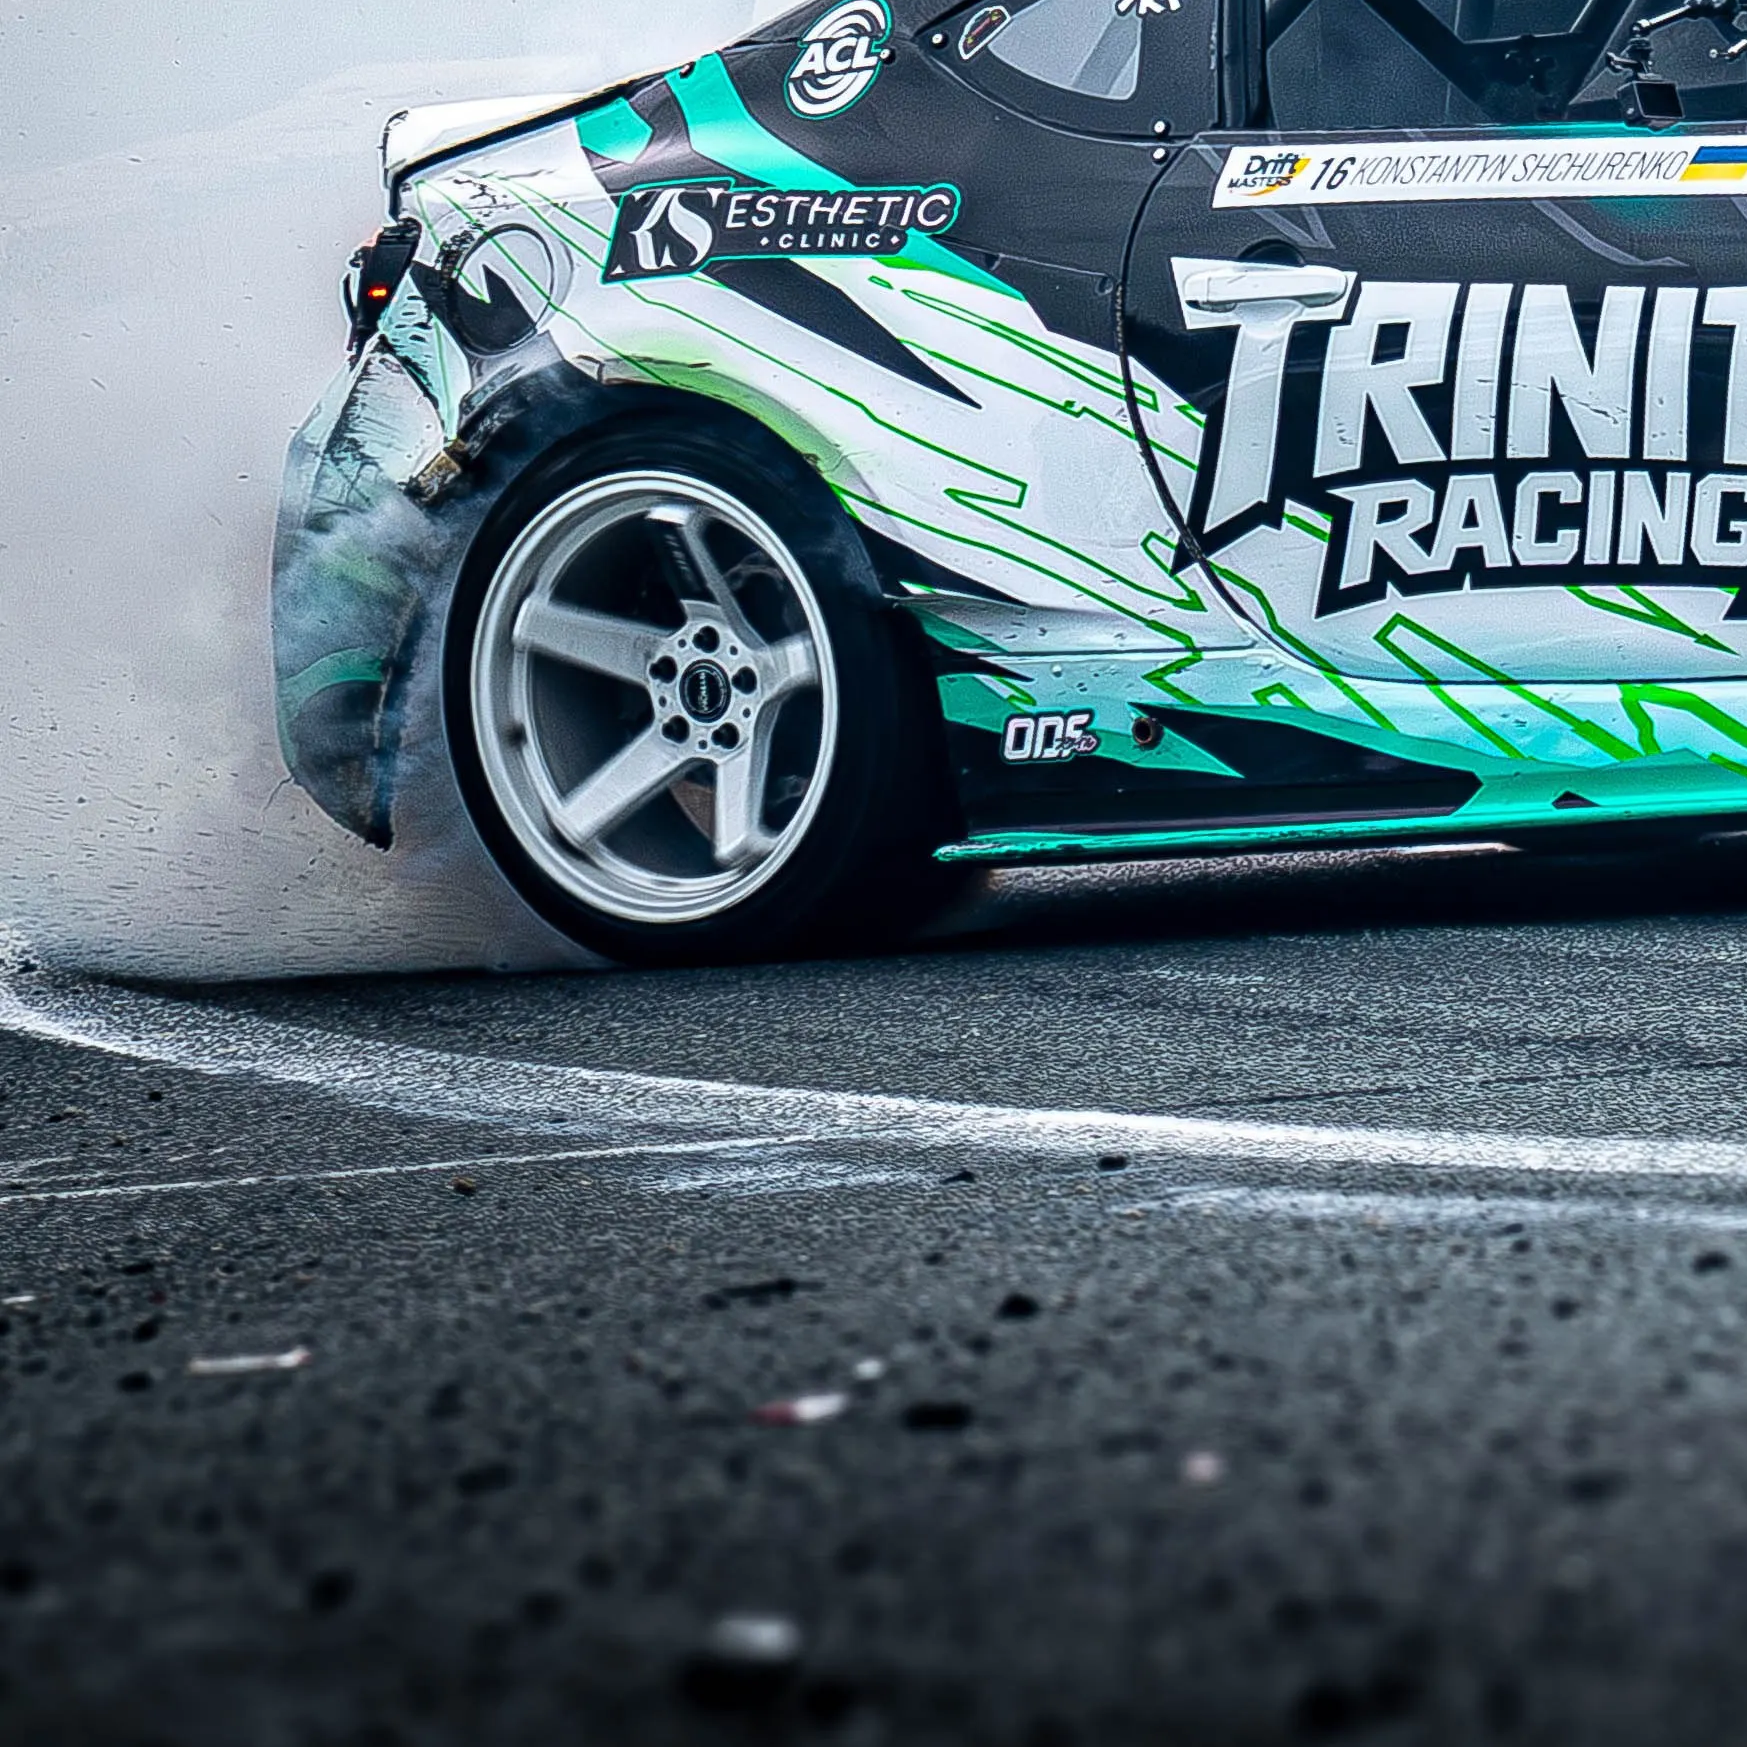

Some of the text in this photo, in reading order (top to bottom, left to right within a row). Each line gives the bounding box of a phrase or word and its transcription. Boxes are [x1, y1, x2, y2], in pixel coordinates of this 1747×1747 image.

[789, 35, 879, 79] ACL
[1244, 153, 1301, 176] Drift
[1310, 150, 1689, 191] 16 KONSTANTYN SHCHURENKO
[1227, 176, 1294, 189] MASTERS
[725, 193, 951, 229] ESTHETIC
[778, 232, 882, 249] CLINIC
